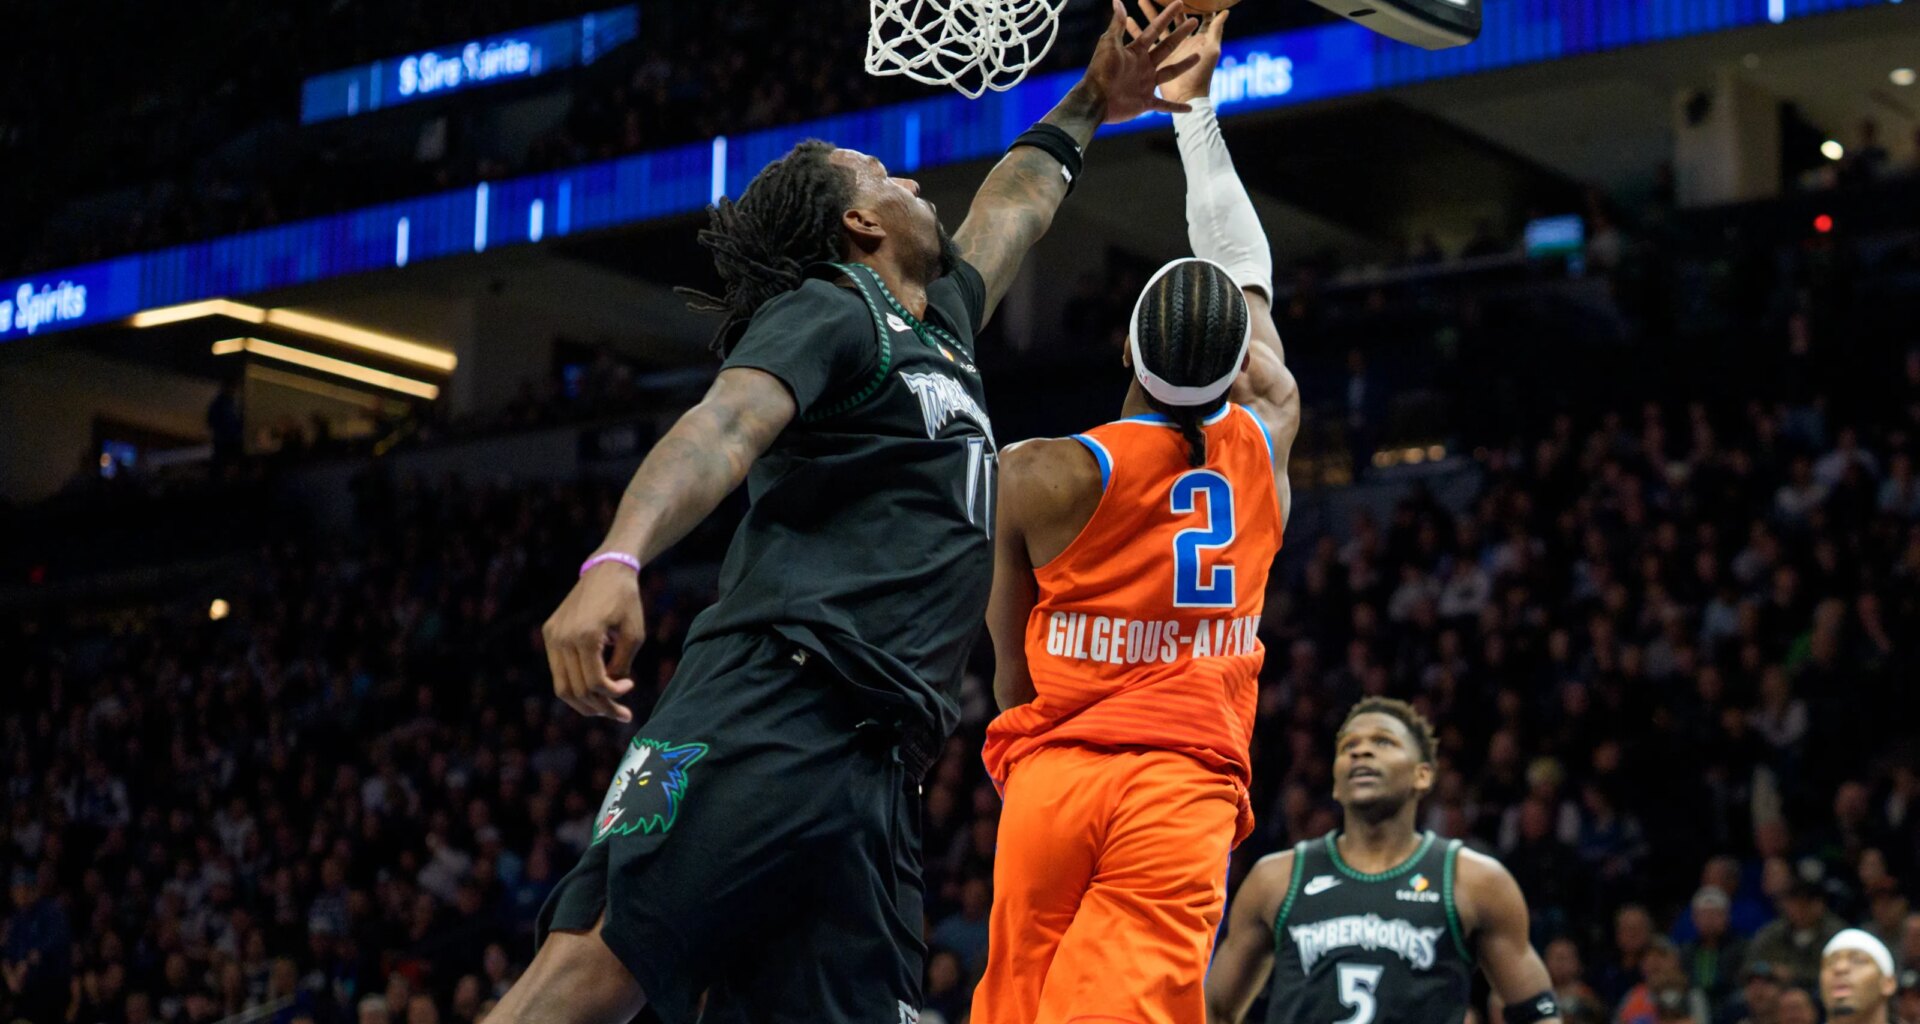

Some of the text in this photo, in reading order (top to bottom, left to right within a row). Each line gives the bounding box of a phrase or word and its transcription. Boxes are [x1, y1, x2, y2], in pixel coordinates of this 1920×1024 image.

[15, 280, 87, 335] Spirits
[1170, 468, 1236, 608] 2
[1288, 912, 1445, 977] TIMBERWOLVES
[1333, 962, 1385, 1024] 5
